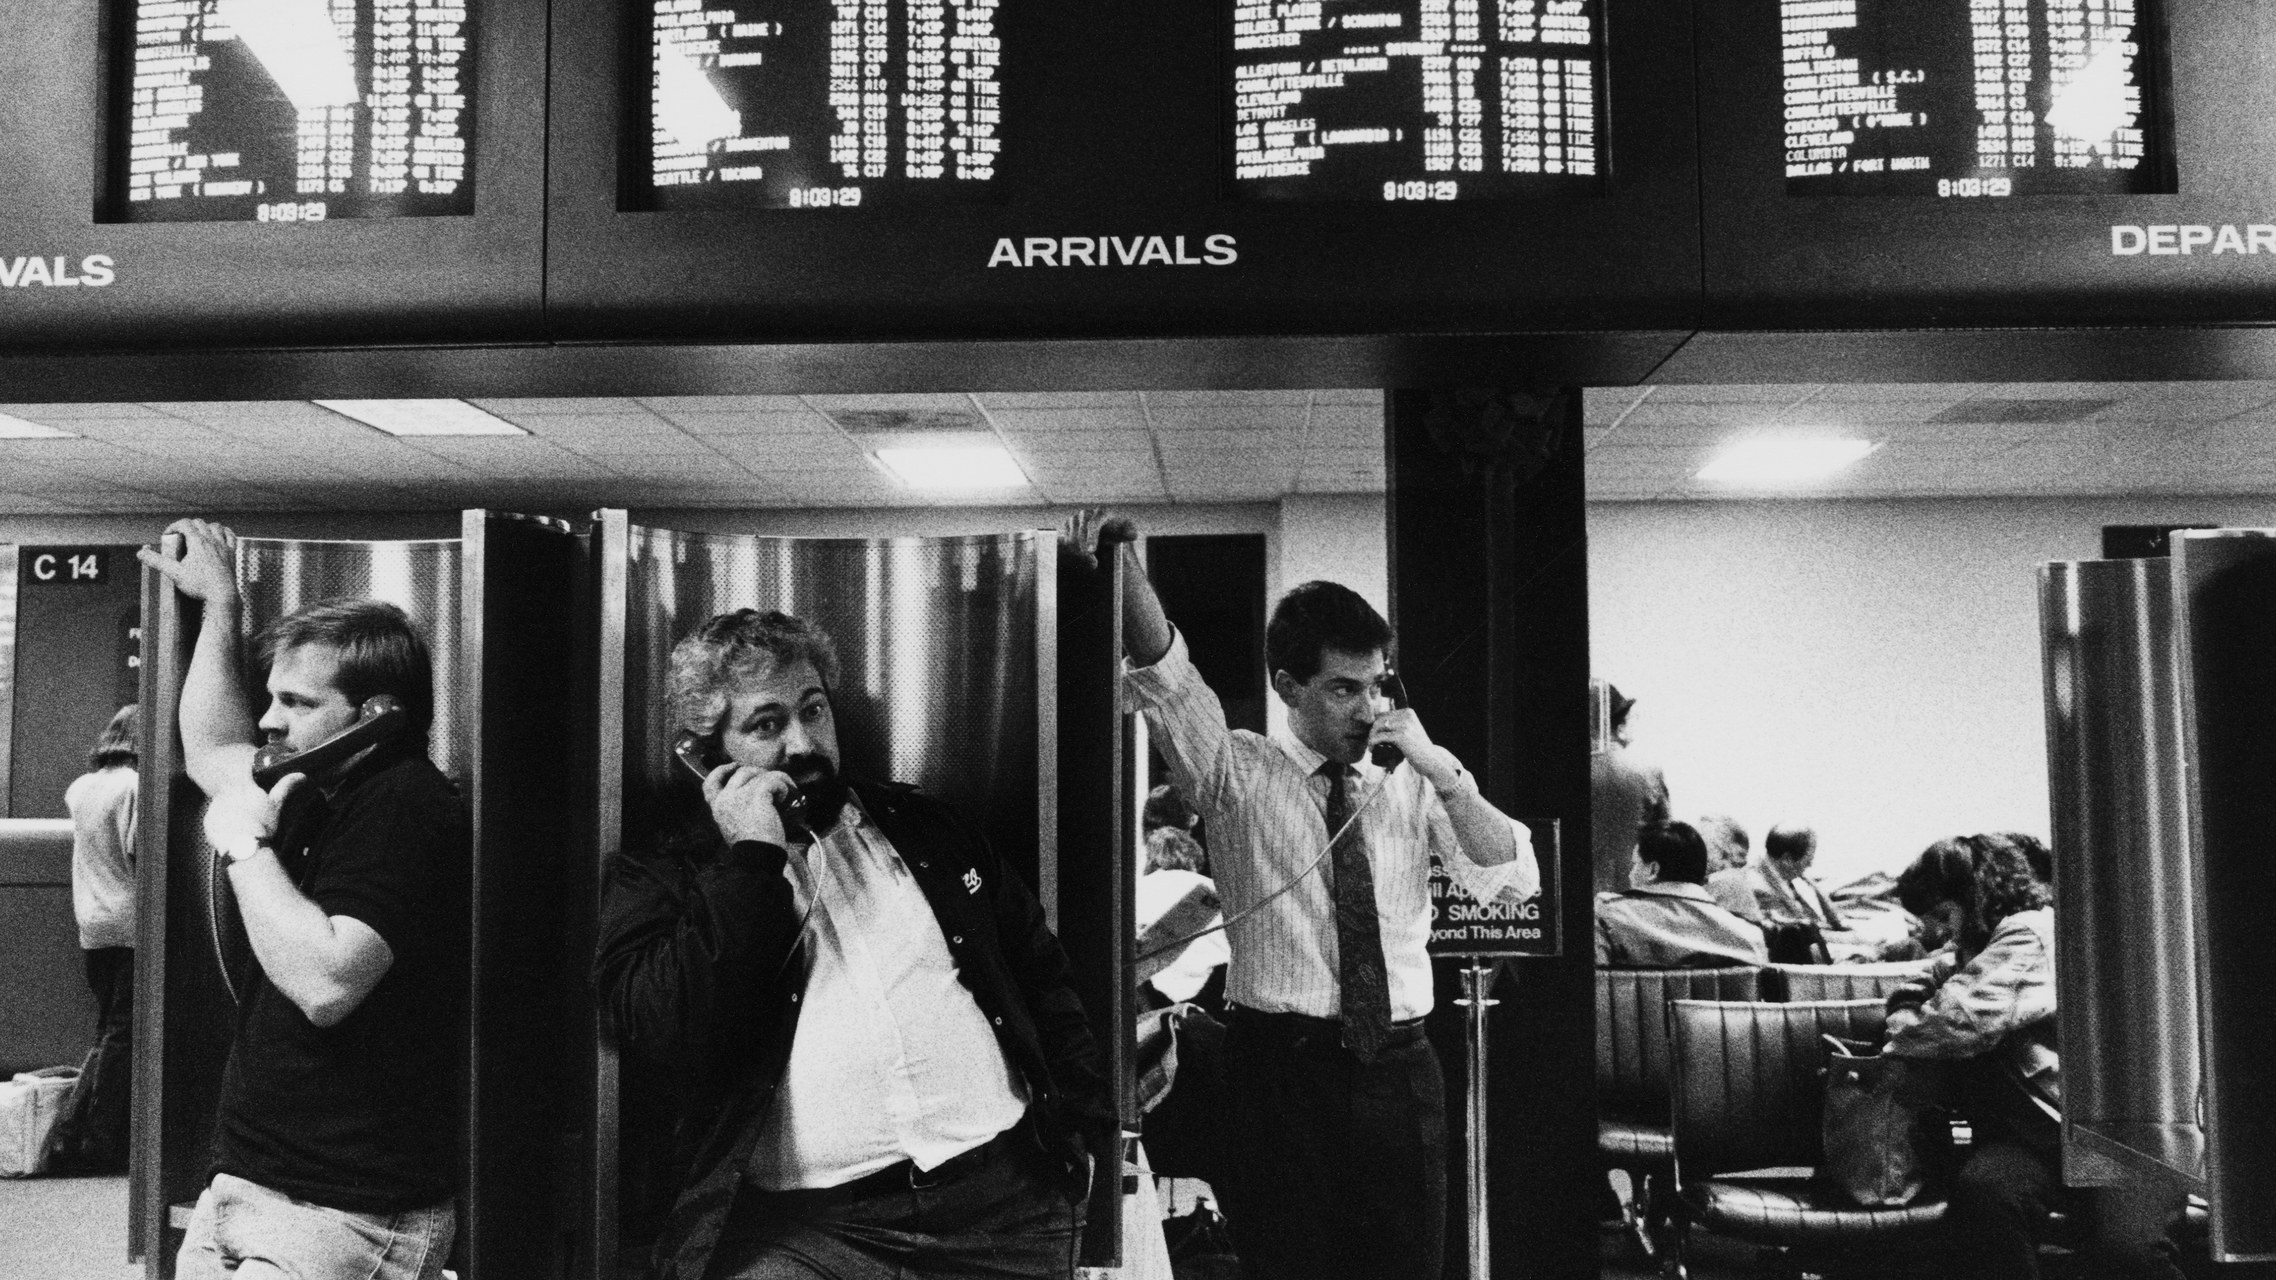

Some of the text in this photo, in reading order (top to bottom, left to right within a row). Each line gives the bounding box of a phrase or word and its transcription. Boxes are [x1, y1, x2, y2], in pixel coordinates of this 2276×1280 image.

[864, 21, 887, 33] C14
[865, 36, 887, 48] C22
[973, 52, 999, 65] TIME
[830, 79, 1000, 94] 2566 A10 8:42P ON TIME
[1236, 74, 1343, 92] CHARLOTTESVILLE
[901, 94, 944, 106] 10:22P
[951, 96, 965, 106] ON
[974, 97, 999, 108] TIME
[1236, 90, 1301, 107] CLEVELAND
[1784, 85, 1896, 104] CHARLOTTESVILLE
[1237, 106, 1286, 120] DETROIT
[1785, 99, 1897, 119] CHARLOTTESVILLE
[864, 121, 885, 134] C11
[1236, 123, 1258, 136] LOS
[1264, 119, 1315, 133] ANGELES
[1459, 114, 1481, 125] C27
[1459, 129, 1481, 141] C22
[1503, 130, 1538, 142] 7:55A
[1568, 133, 1593, 145] TIME
[1785, 131, 1854, 147] CLEVELAND
[1237, 147, 1324, 164] PHILADELPHIA
[1787, 147, 1846, 161] COLUMBIA
[1979, 155, 2006, 167] 1271
[2013, 155, 2034, 166] C14
[653, 170, 700, 185] SEATTLE
[864, 164, 886, 177] C17
[1384, 182, 1457, 200] 8:03:29
[1938, 178, 2011, 196] 8:03:29
[790, 188, 861, 207] 8:03:29
[257, 203, 326, 222] 8:03:29
[2111, 224, 2276, 256] DEPAR
[986, 233, 1238, 268] ARRIVALS
[0, 254, 115, 287] VALS
[34, 553, 99, 580] C 14
[1448, 902, 1540, 921] SMOKING
[1430, 924, 1541, 942] yond This Area
